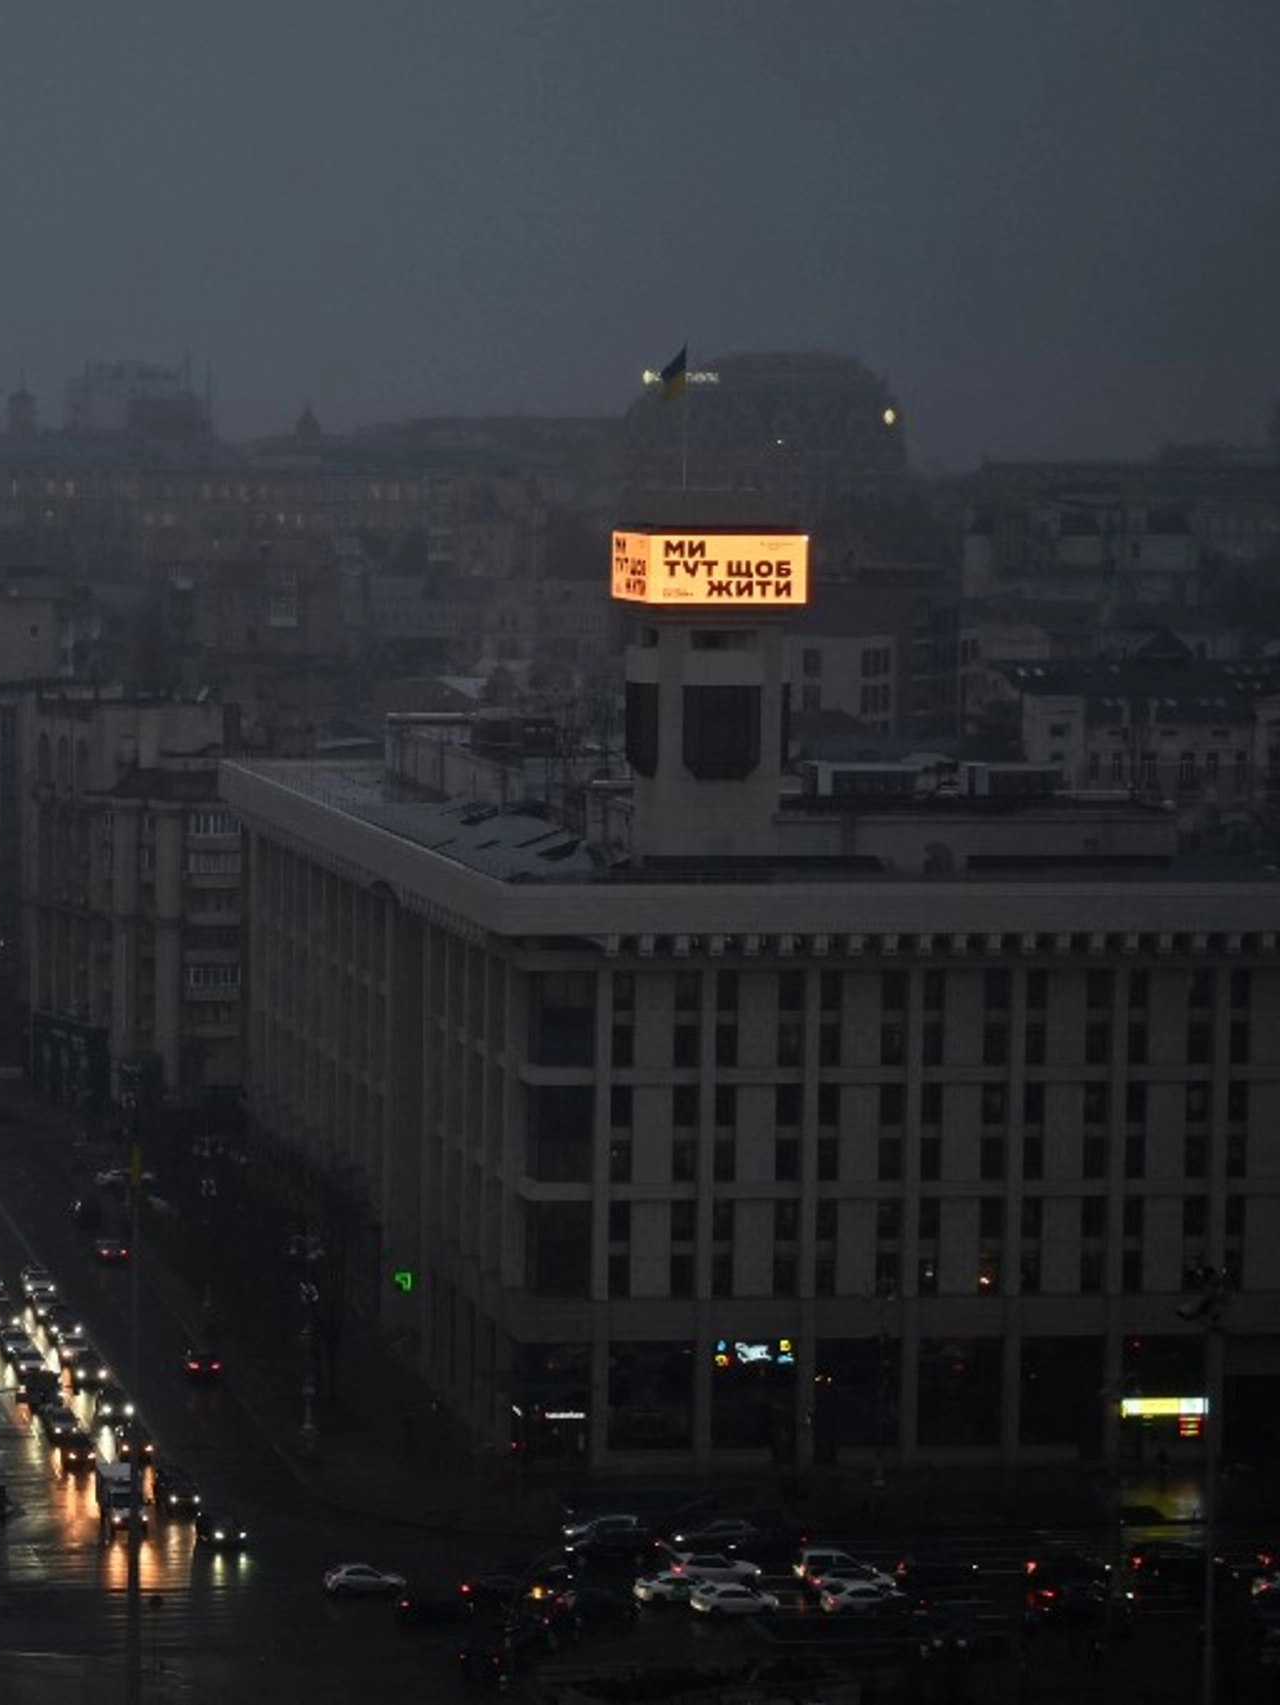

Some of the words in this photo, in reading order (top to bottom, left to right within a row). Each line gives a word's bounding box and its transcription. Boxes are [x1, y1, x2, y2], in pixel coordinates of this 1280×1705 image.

[664, 540, 706, 558] МИ
[663, 560, 718, 578] ТУТ
[727, 560, 793, 578] ЩОБ
[706, 580, 793, 598] ЖИТИ
